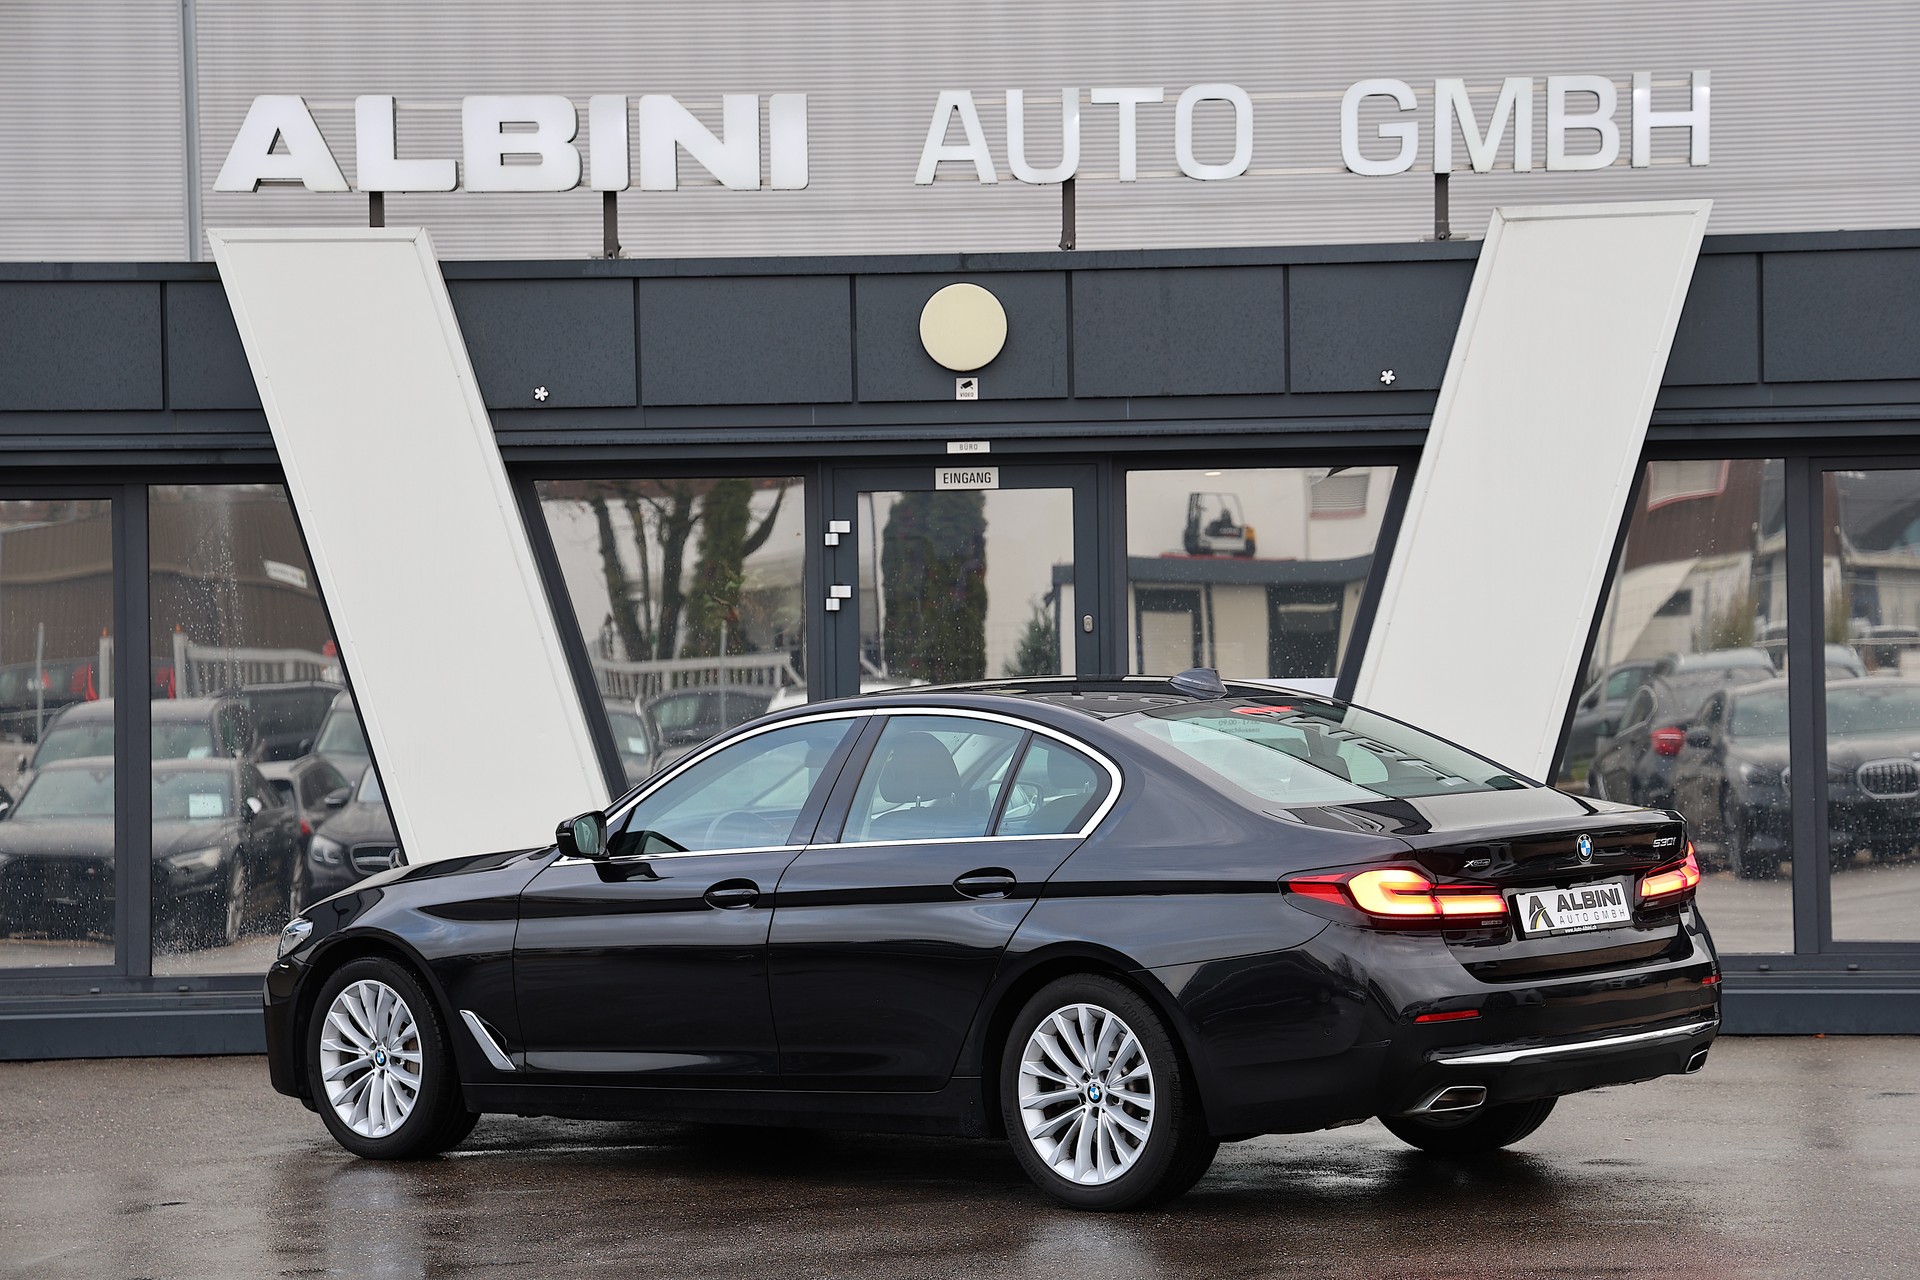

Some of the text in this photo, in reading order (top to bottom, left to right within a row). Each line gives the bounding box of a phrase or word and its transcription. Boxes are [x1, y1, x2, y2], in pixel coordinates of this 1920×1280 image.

[212, 69, 1712, 192] ALBINI AUTO GMBH
[959, 443, 978, 451] BÜRO
[943, 471, 992, 484] EINGANG
[1652, 836, 1677, 848] 530i
[1557, 887, 1622, 913] ALBINI
[1559, 908, 1626, 926] AUTO GMBH
